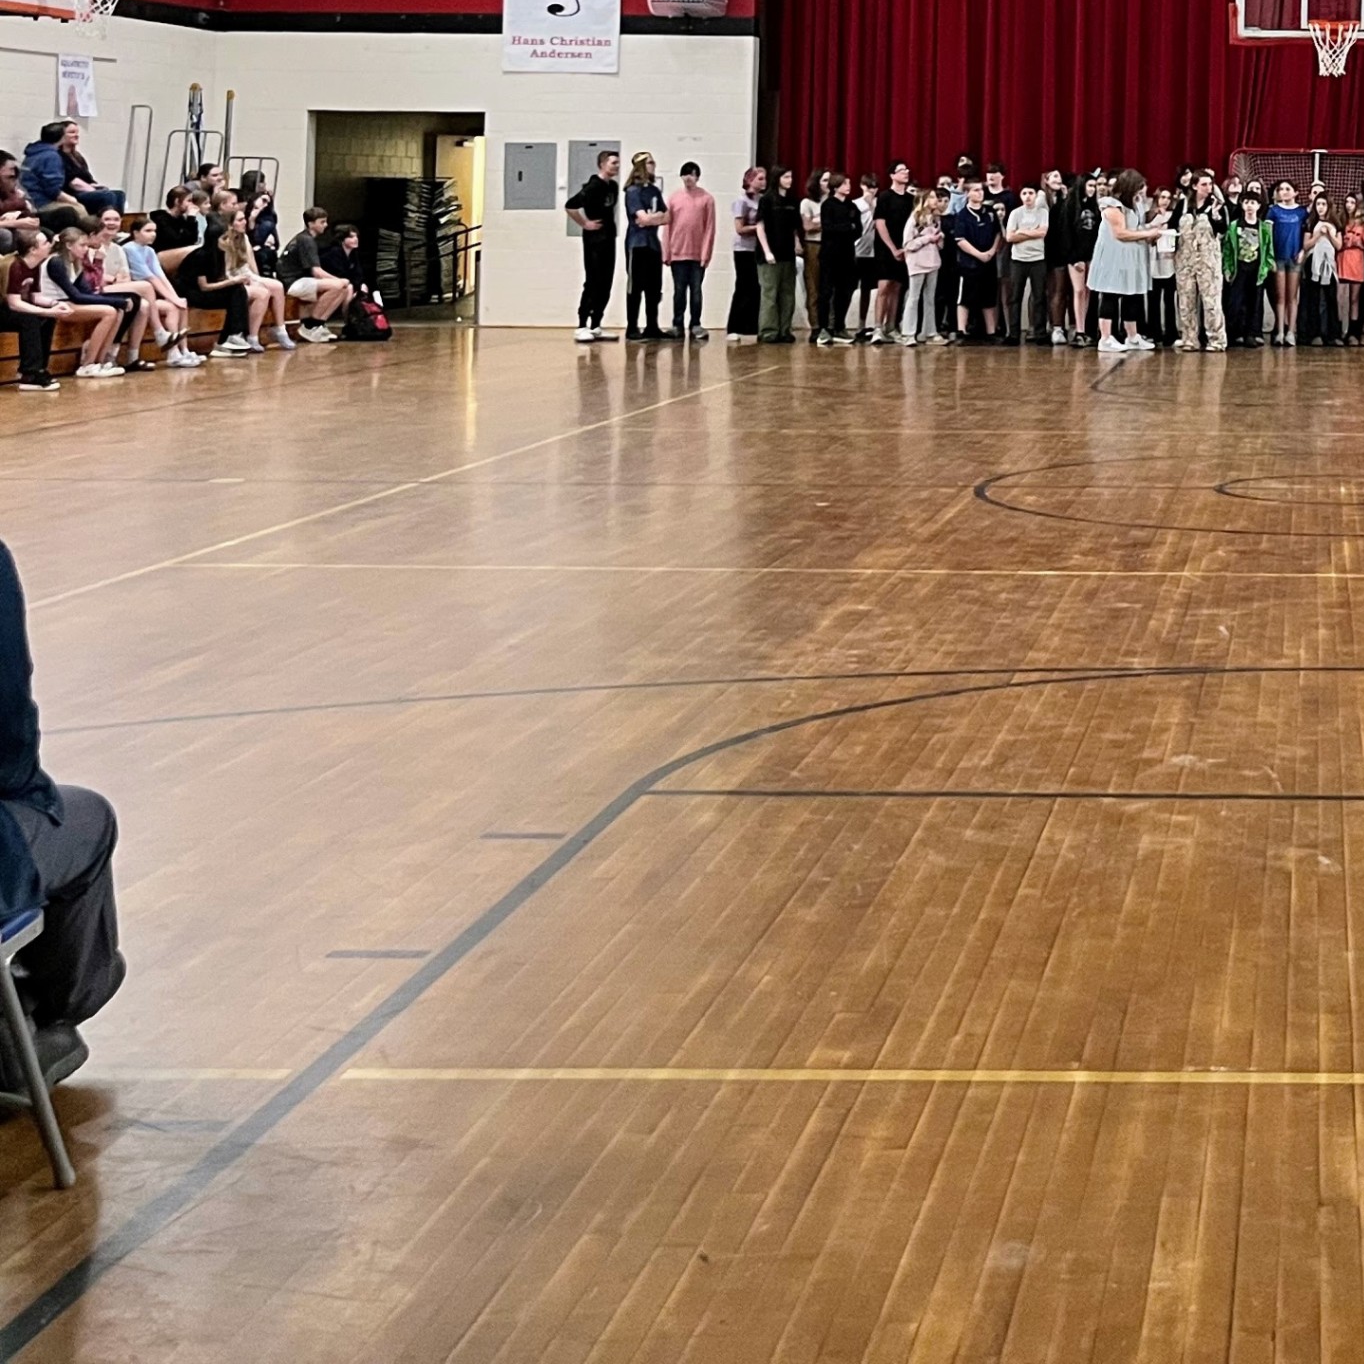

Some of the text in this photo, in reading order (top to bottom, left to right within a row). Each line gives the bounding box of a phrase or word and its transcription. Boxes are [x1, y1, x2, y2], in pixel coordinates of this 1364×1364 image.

[511, 35, 612, 47] Hans Christian
[530, 48, 593, 59] Andersen
